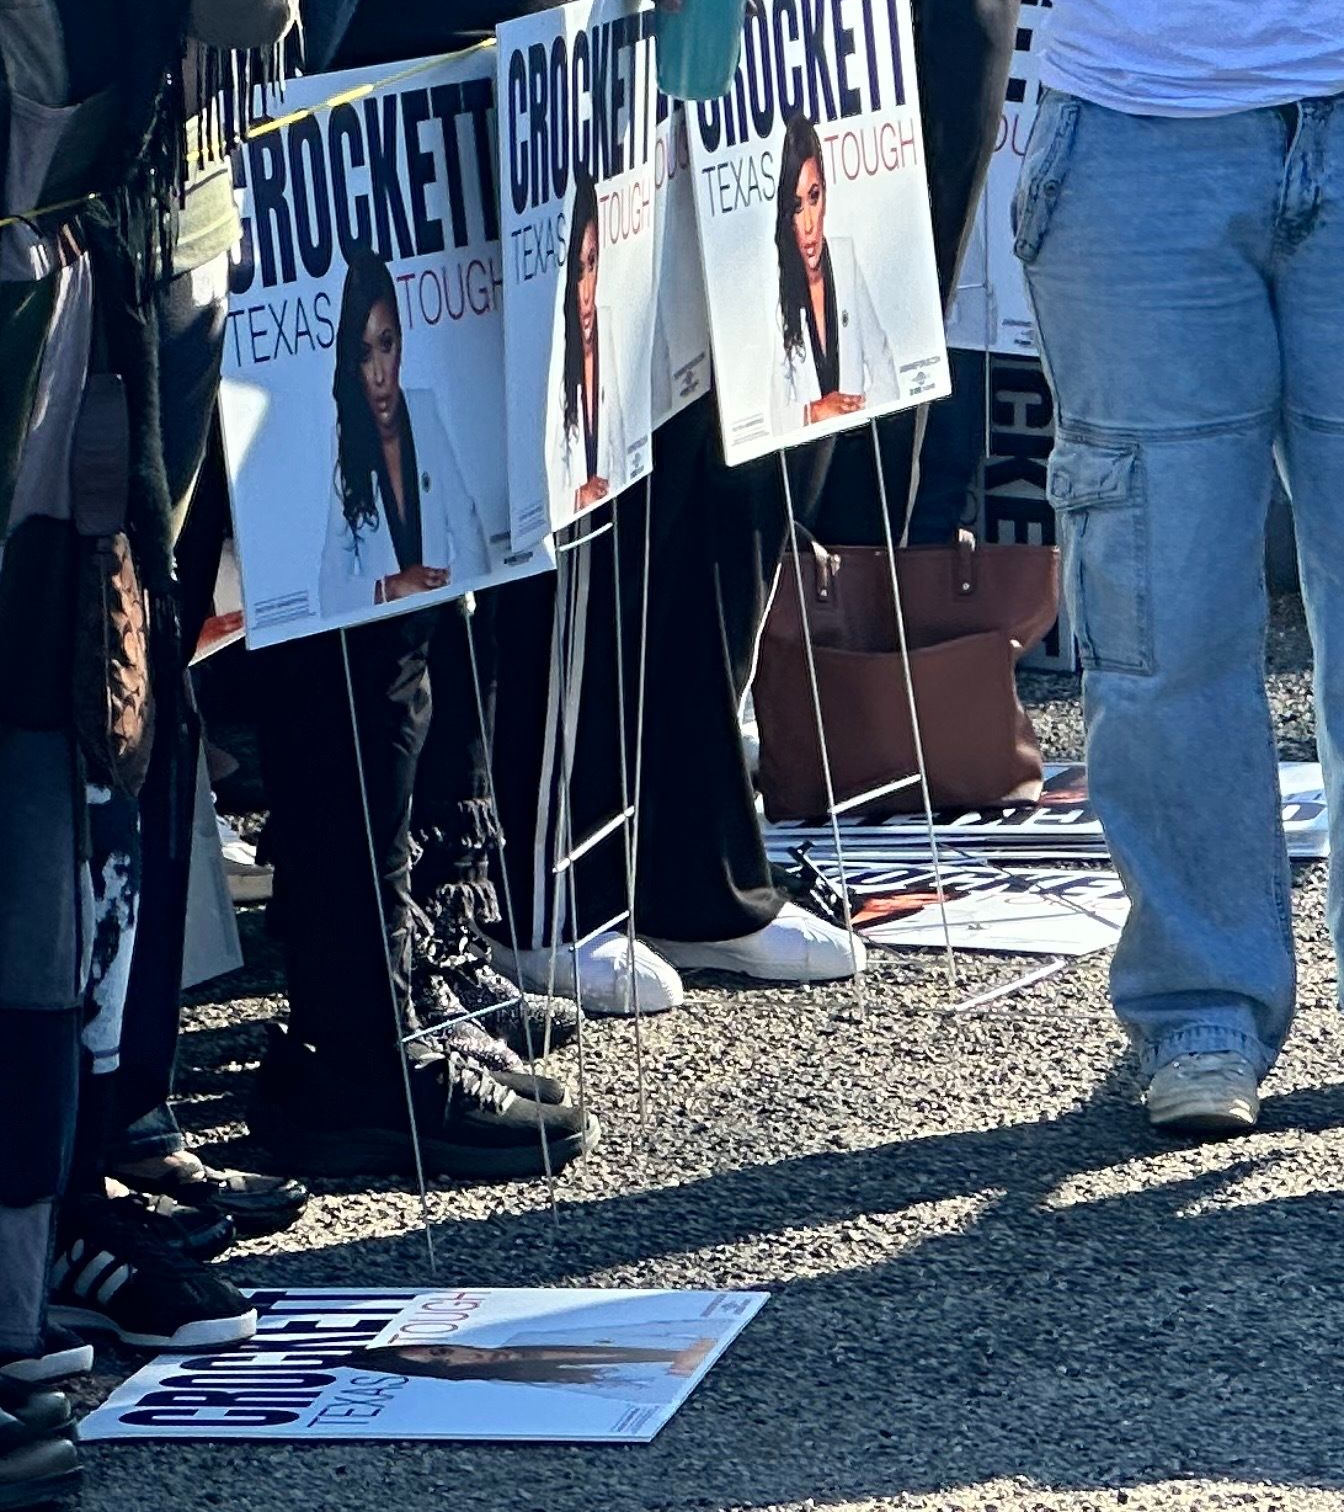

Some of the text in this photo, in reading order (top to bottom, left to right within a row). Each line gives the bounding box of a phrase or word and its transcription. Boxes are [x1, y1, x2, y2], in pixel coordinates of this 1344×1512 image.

[508, 8, 656, 216] CROCKETT
[702, 150, 777, 217] TEXAS
[824, 118, 918, 185] TOUGH
[511, 180, 650, 286] TEXAS TOUGH
[227, 291, 336, 368] TEXAS
[306, 1291, 493, 1428] TOUGH TEXAS
